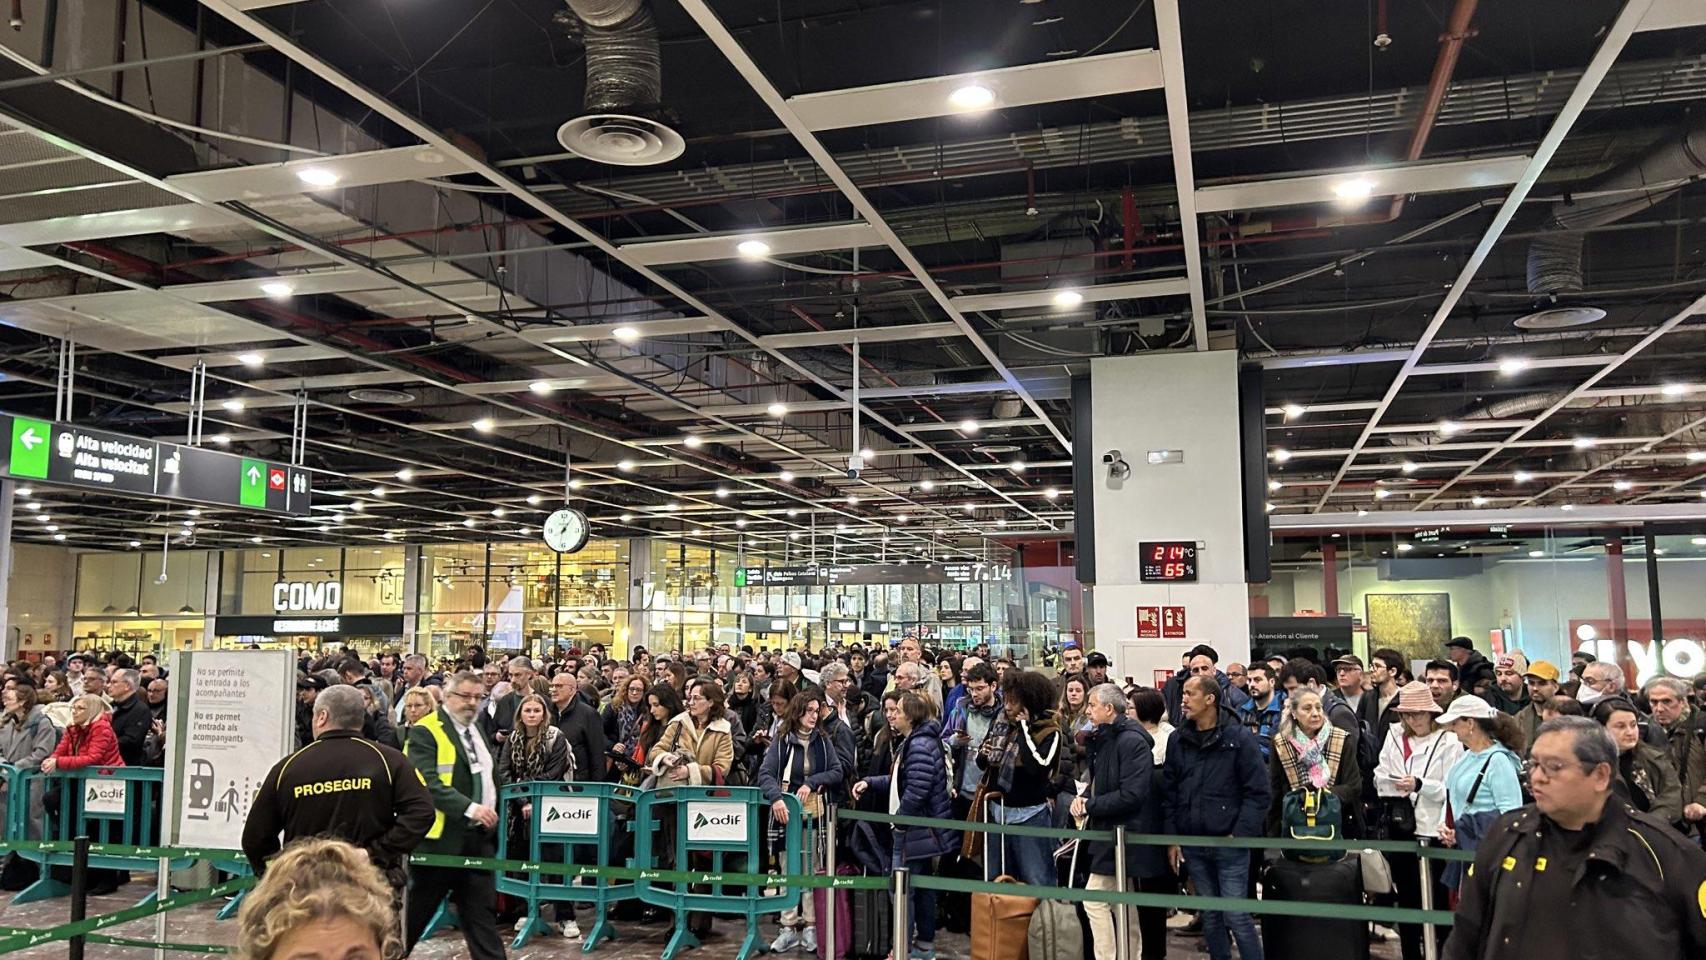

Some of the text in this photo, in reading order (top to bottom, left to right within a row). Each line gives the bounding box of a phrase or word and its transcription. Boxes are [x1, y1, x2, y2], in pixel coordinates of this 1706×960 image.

[76, 435, 152, 460] Alta velocidad
[75, 452, 149, 475] Alta velocitat
[972, 564, 986, 580] 7
[992, 565, 1012, 580] 14
[1165, 563, 1184, 576] 65
[274, 582, 340, 611] COMO
[218, 669, 244, 677] permite
[196, 689, 246, 698] acompañantes
[193, 722, 238, 731] l'entrada als
[193, 733, 243, 743] acompanyants
[100, 788, 124, 799] adif
[294, 778, 371, 798] PROSEGUR
[562, 809, 592, 820] adif
[710, 814, 742, 826] adif
